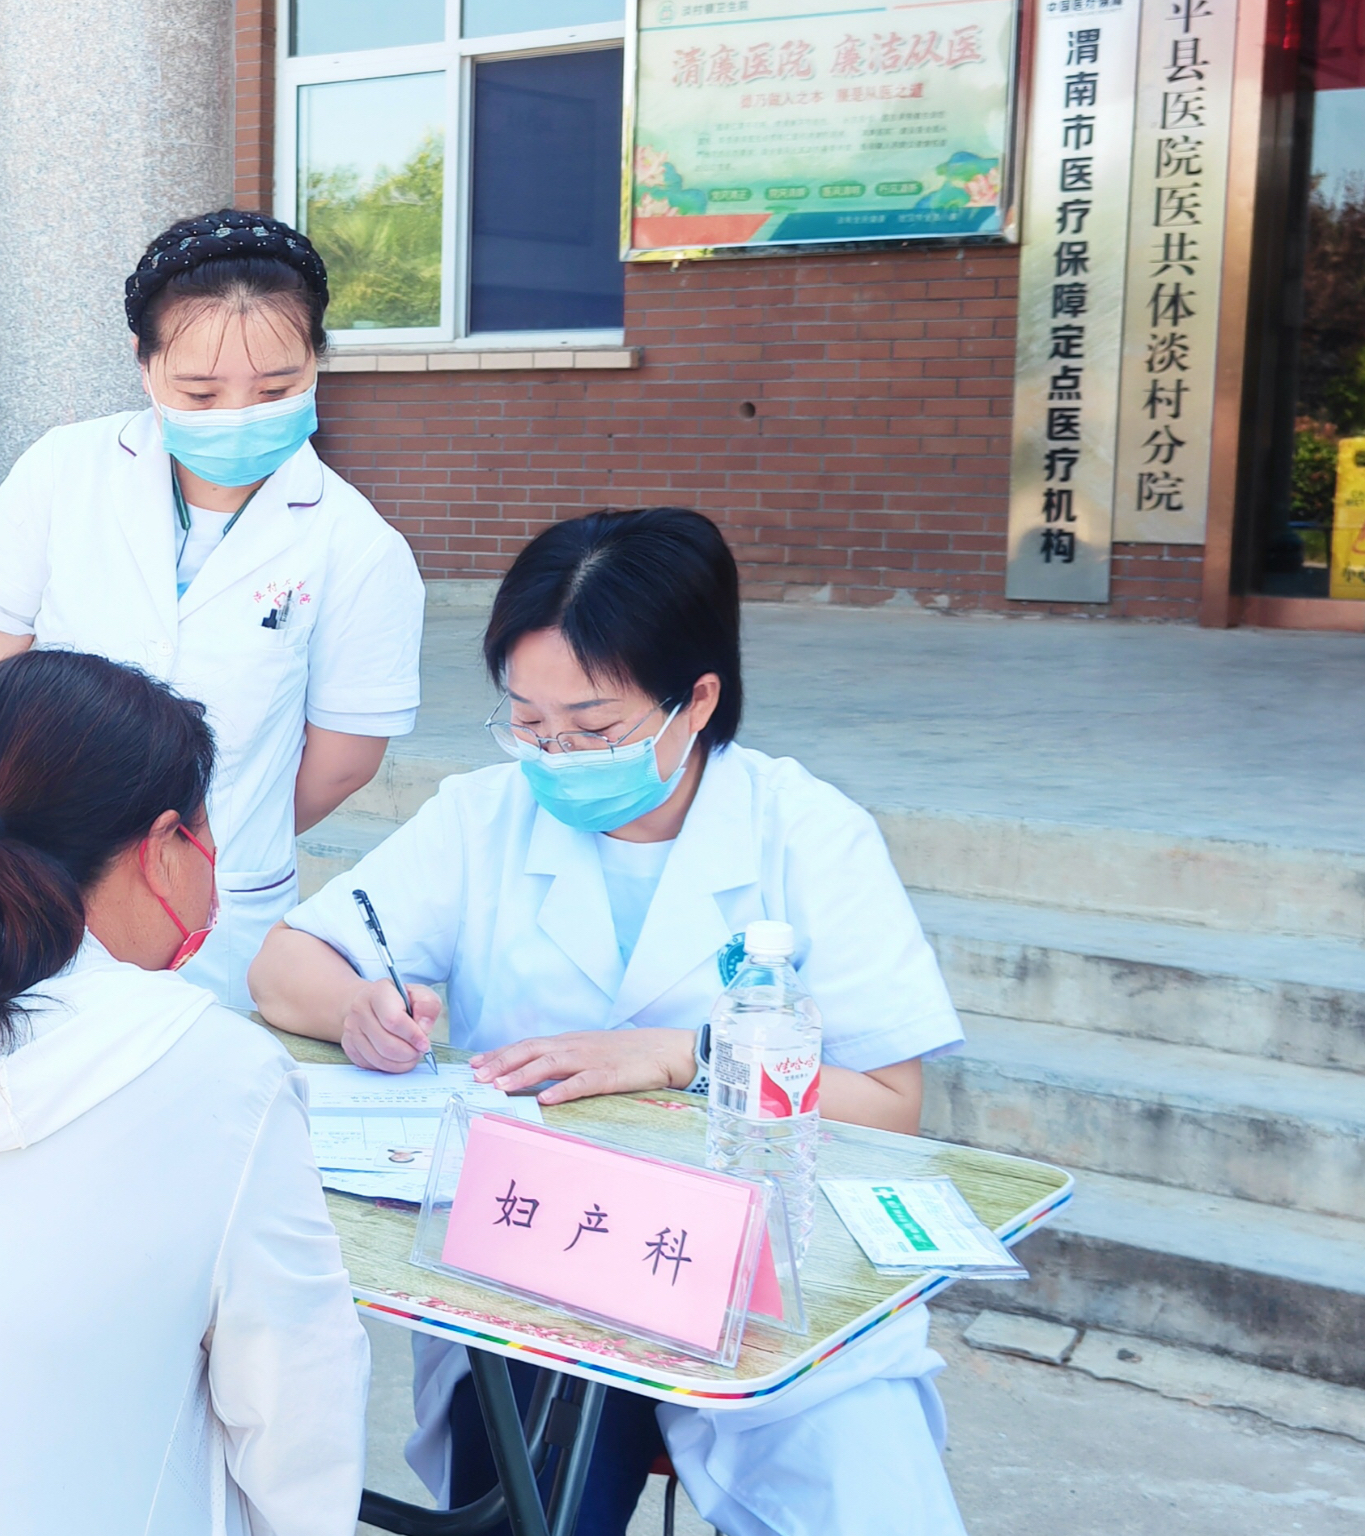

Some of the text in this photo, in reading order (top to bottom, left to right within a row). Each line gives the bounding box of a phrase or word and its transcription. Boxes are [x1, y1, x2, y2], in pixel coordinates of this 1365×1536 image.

[1039, 27, 1102, 565] 渭南市医疗保障定点医疗机构
[493, 1178, 694, 1287] 妇产科
